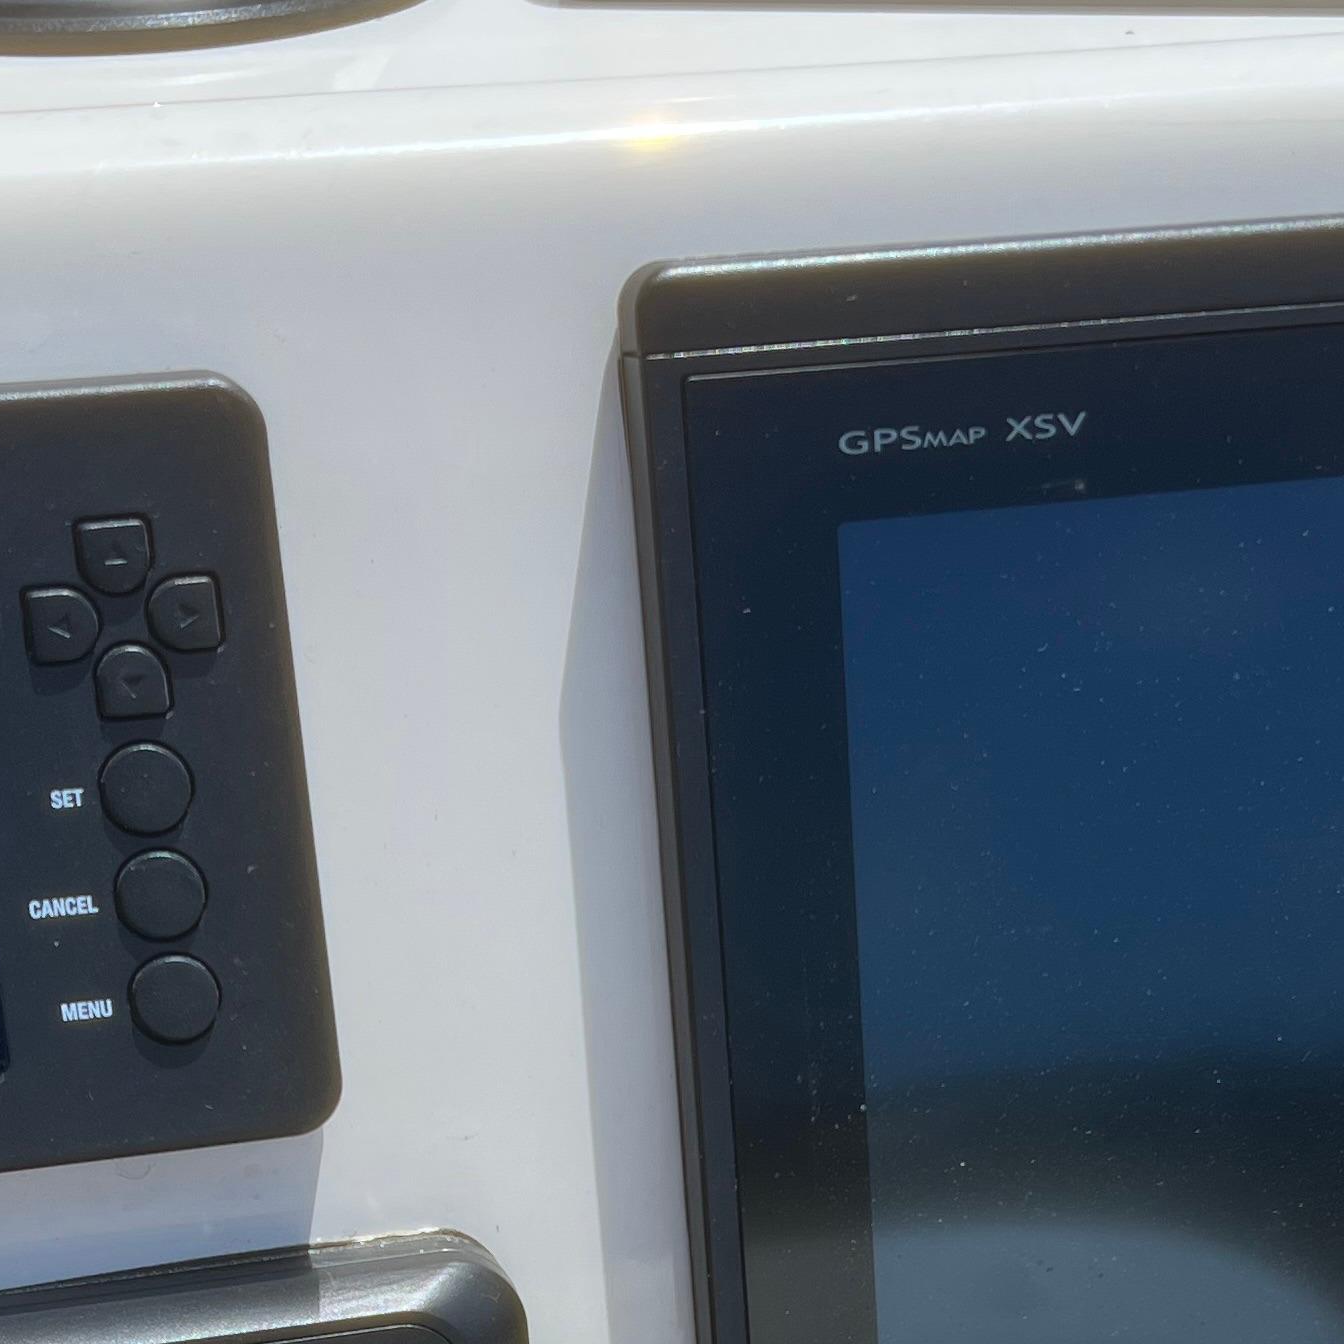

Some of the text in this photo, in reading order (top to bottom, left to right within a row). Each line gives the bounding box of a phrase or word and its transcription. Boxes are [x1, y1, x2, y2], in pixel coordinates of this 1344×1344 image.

[1006, 411, 1087, 441] XSV
[50, 788, 83, 810] SET
[29, 894, 98, 919] CANCEL
[61, 999, 113, 1022] MENU
